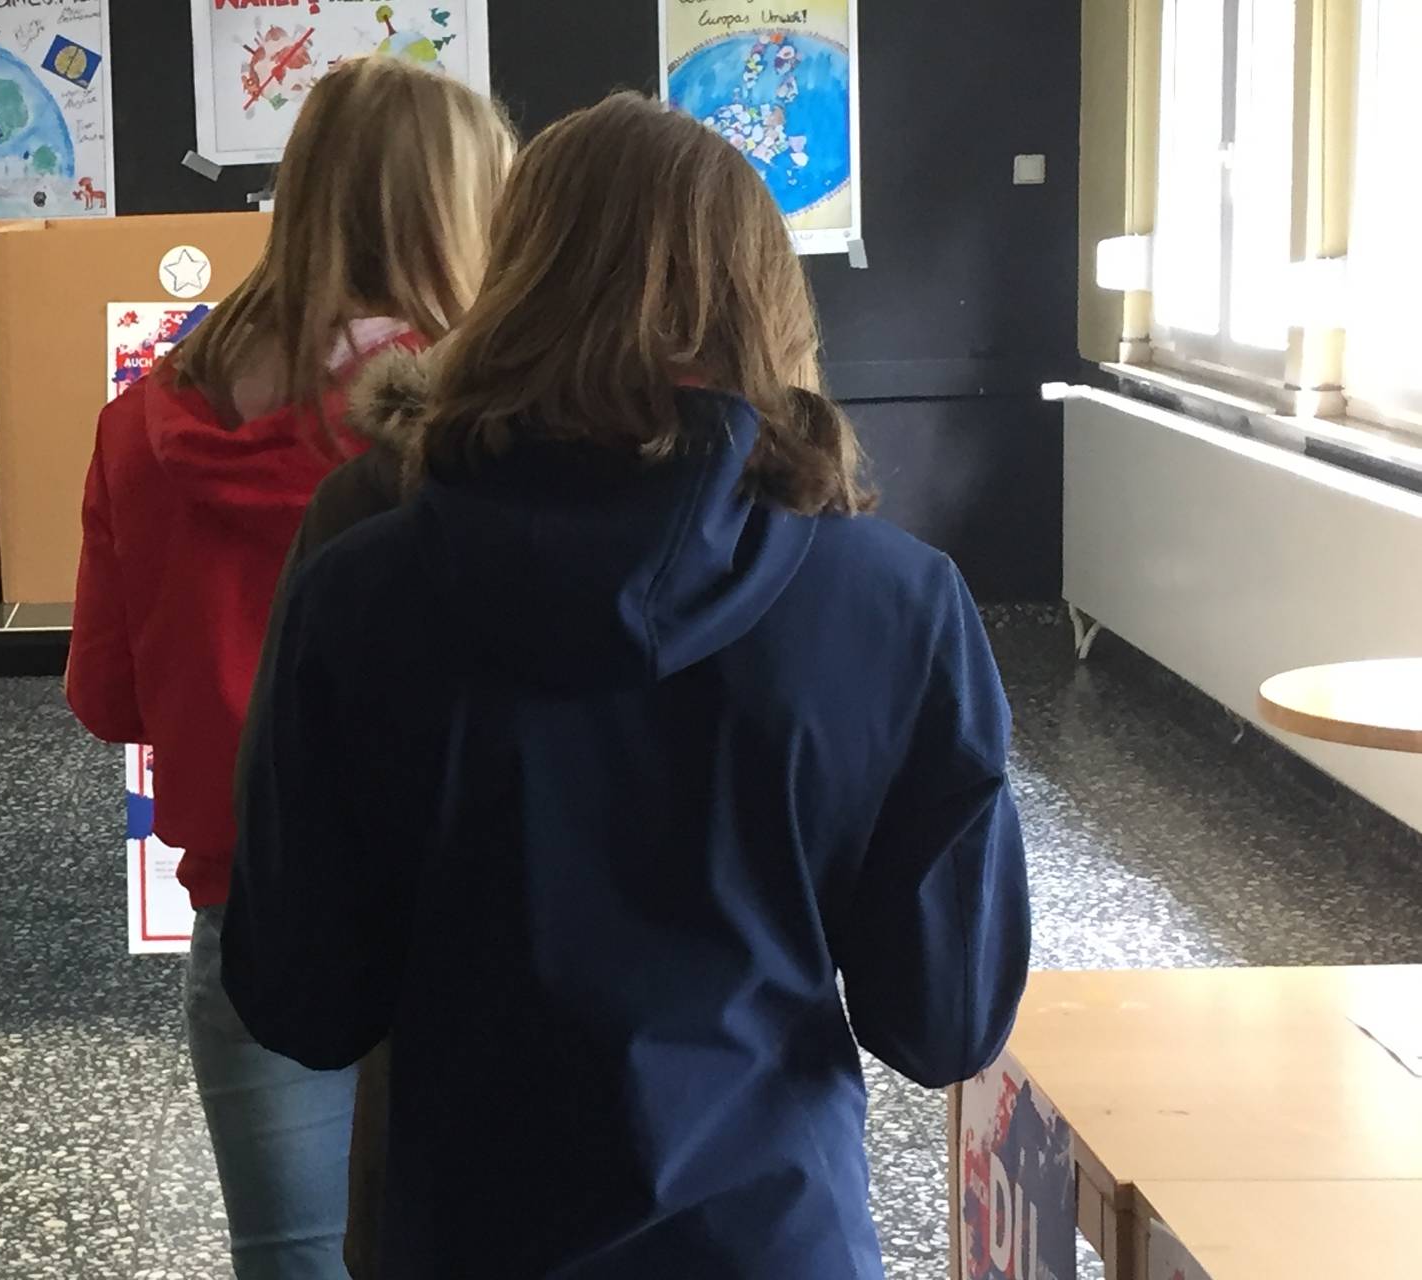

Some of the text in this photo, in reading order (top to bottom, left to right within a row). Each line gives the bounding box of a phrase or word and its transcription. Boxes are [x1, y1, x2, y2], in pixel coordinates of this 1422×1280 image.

[698, 9, 750, 29] Europas
[123, 358, 153, 368] AUCH
[989, 1150, 1038, 1280] DU
